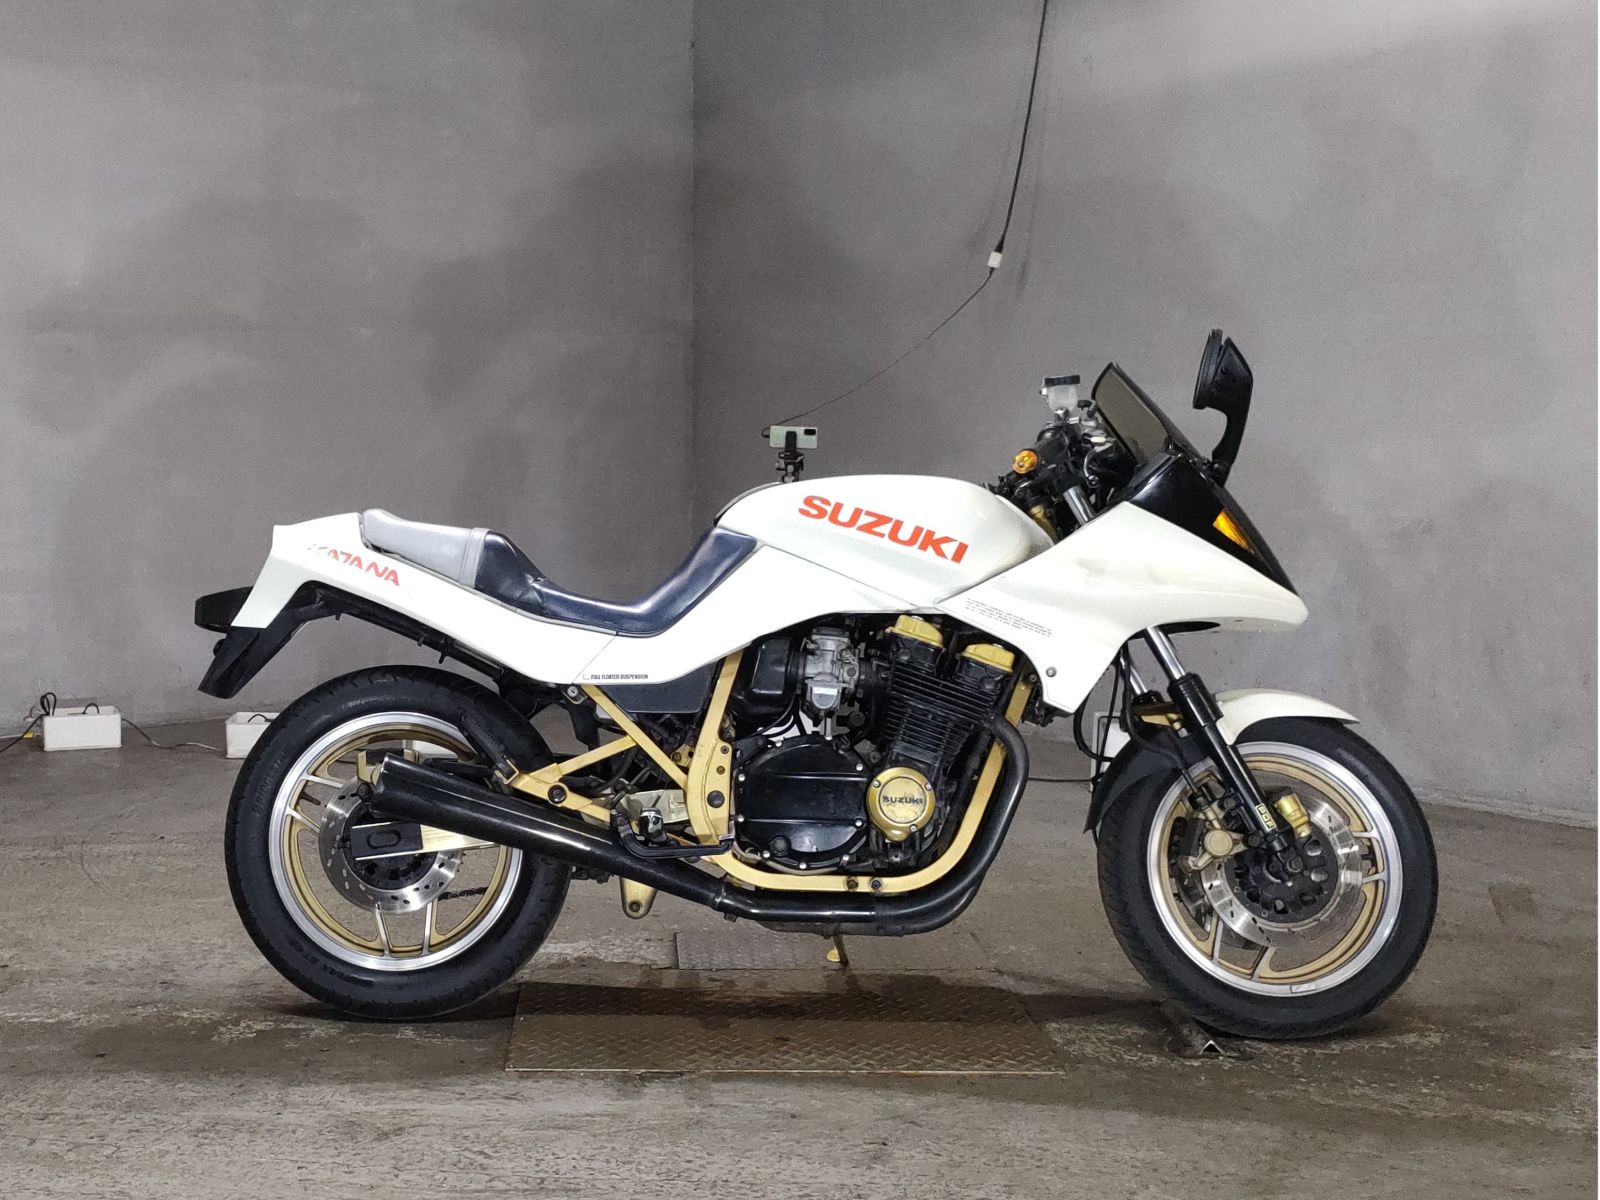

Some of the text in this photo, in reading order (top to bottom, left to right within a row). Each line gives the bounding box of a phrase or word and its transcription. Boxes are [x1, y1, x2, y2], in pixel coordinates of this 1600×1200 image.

[798, 495, 969, 564] SUZUKI
[308, 543, 399, 586] ATANA
[882, 795, 923, 804] SUZUKI
